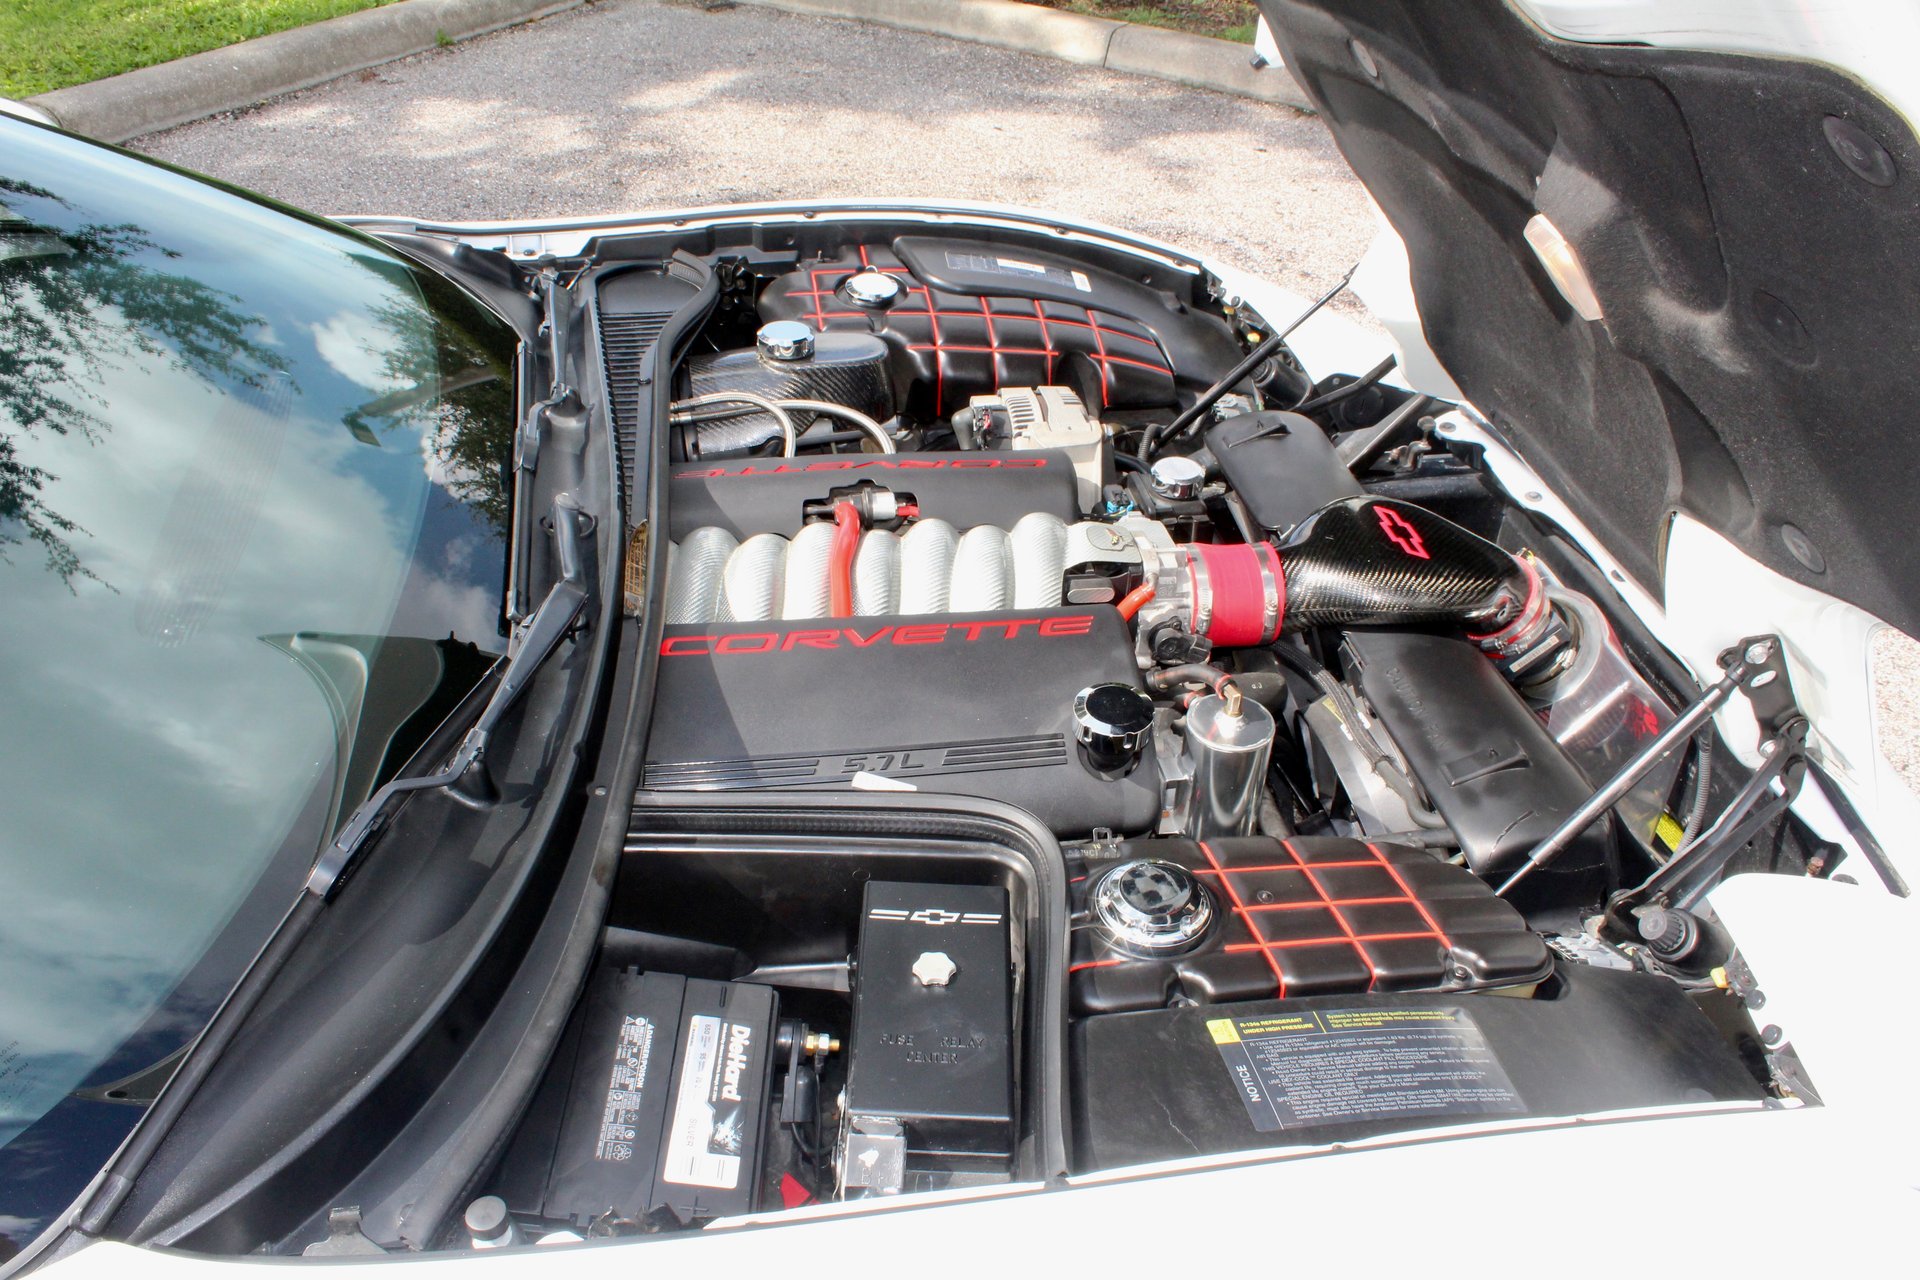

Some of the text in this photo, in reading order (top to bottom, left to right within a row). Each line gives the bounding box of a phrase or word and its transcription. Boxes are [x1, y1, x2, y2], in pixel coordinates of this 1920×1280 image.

[673, 459, 1047, 480] CORVETTE
[660, 616, 1094, 657] CORVETTE
[841, 752, 924, 774] 5.7L
[1260, 1017, 1303, 1025] REFRIGERANT
[880, 1033, 985, 1049] FUSE RELAY
[721, 1024, 750, 1101] DieHard
[906, 1051, 958, 1064] CENTER
[1236, 1064, 1262, 1102] NOTICE
[684, 1118, 697, 1147] SILVER
